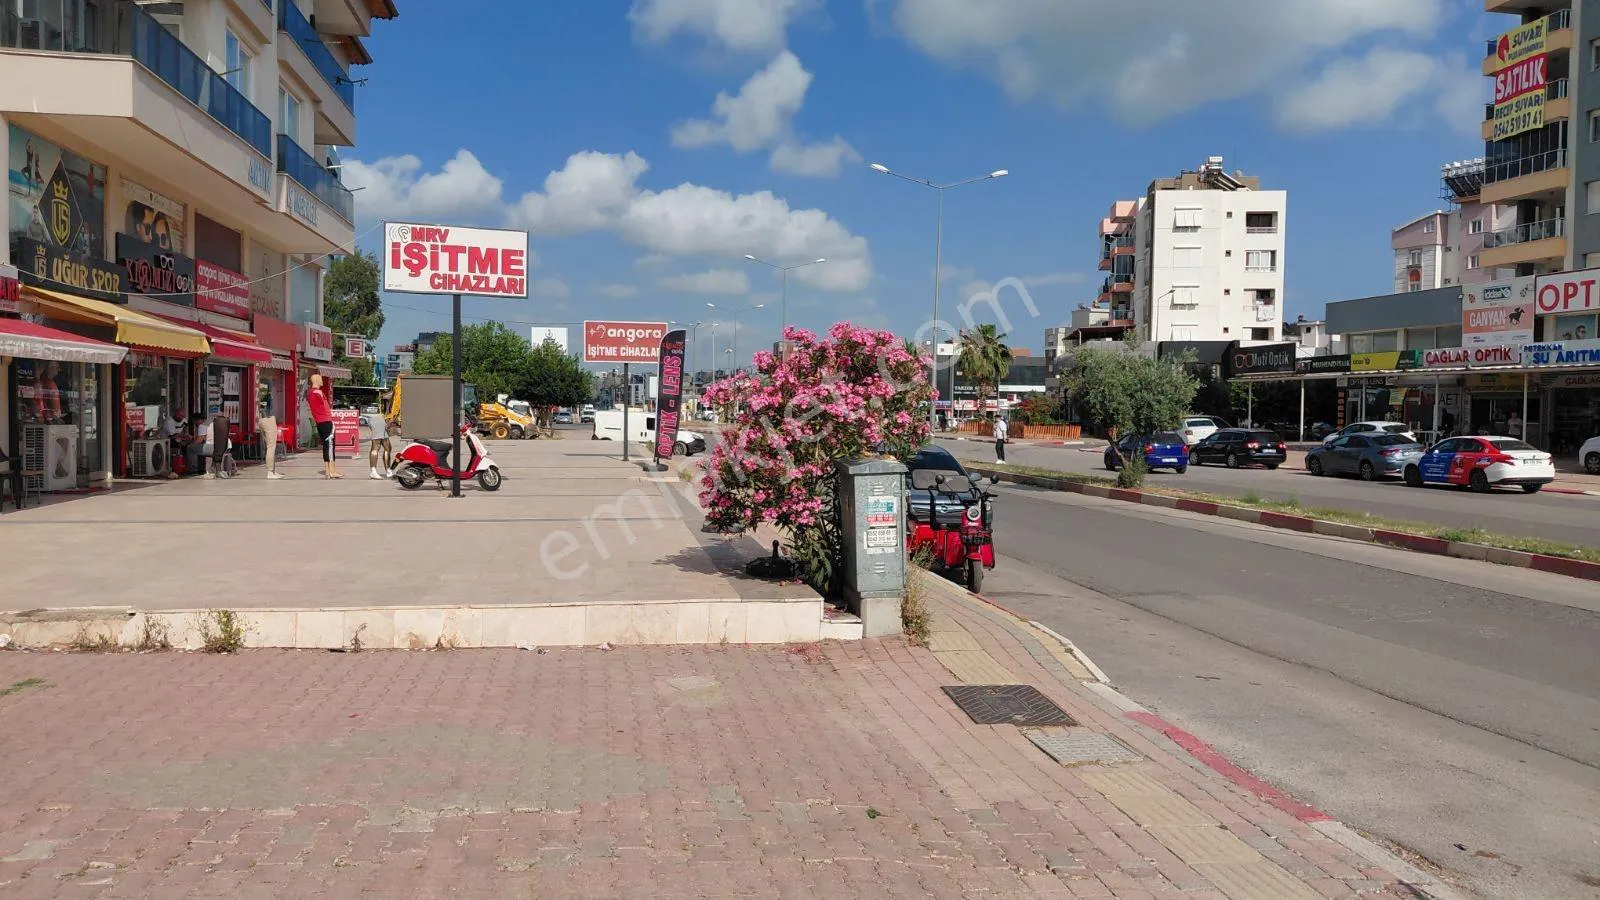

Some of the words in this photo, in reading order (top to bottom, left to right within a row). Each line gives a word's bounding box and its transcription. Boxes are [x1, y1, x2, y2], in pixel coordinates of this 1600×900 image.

[1496, 57, 1544, 101] SATILIK
[410, 227, 450, 243] MRV
[391, 241, 525, 278] İŞİTME
[52, 253, 89, 288] UĞUR
[91, 268, 120, 296] SPOR
[1469, 310, 1506, 328] GANYAN
[607, 328, 662, 342] angora
[351, 341, 363, 353] E
[588, 344, 618, 358] İŞİTME
[1475, 344, 1512, 363] OPTİK
[1268, 351, 1290, 367] Optik
[1533, 352, 1550, 364] SU
[663, 355, 682, 396] LENS
[657, 409, 678, 458] OPTİK
